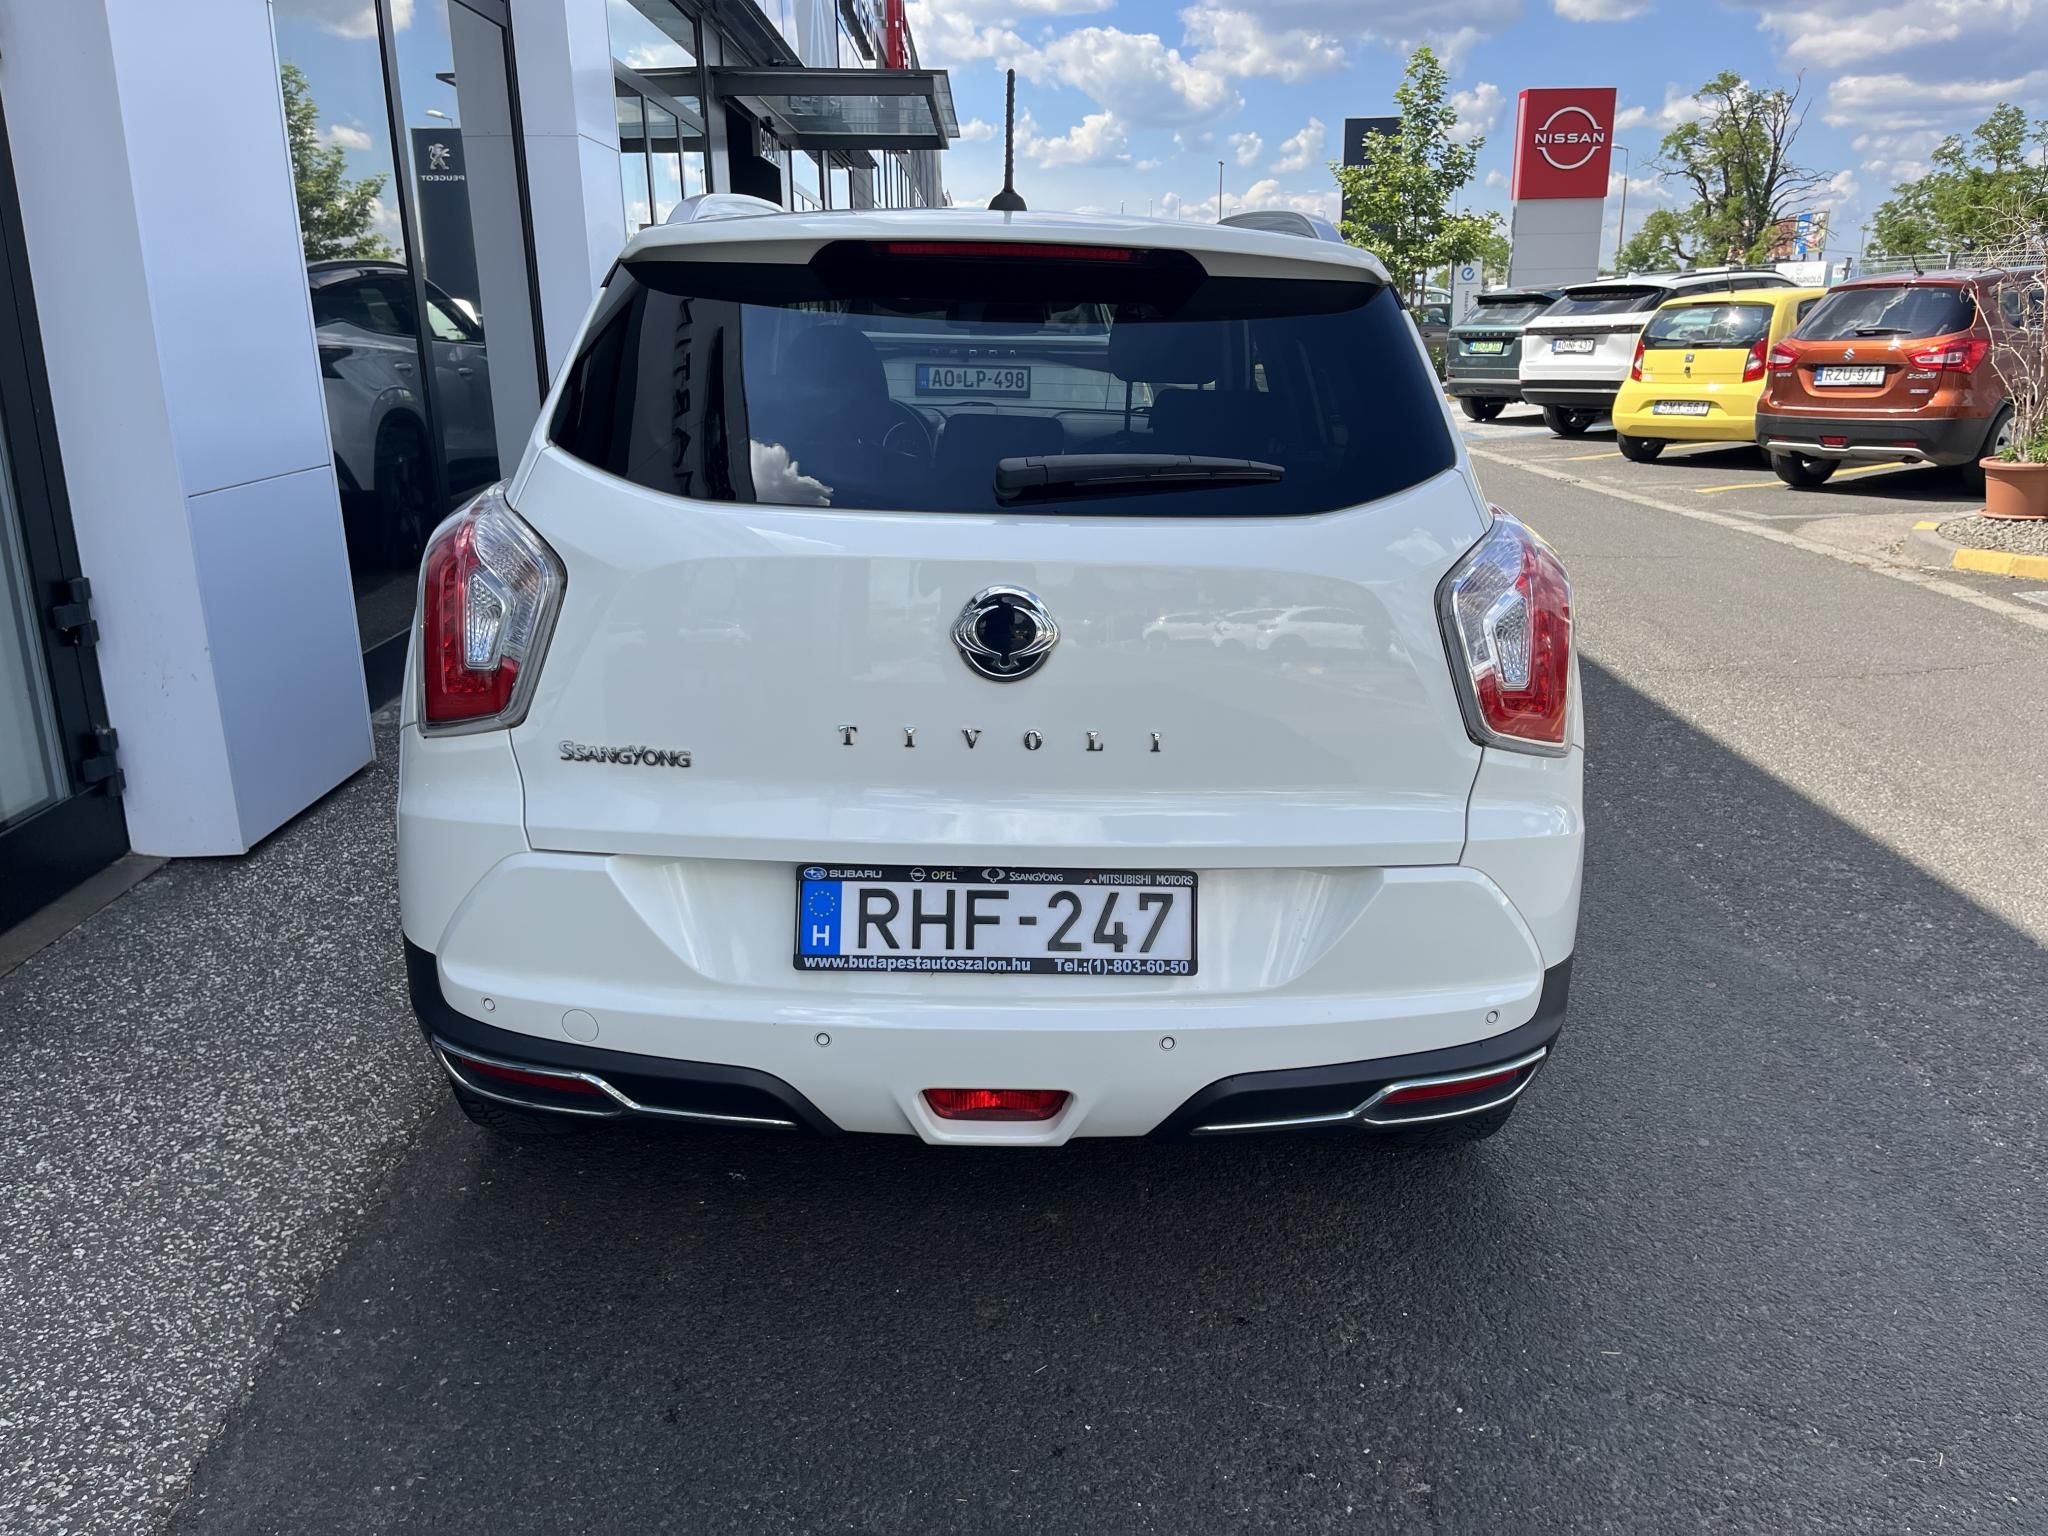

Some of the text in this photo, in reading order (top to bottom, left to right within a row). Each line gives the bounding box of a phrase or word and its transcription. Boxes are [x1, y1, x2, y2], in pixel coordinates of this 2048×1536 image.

[1534, 132, 1605, 144] NISSAN
[1824, 368, 1881, 382] RZU-971
[838, 724, 1161, 753] TIVOLI
[829, 869, 882, 879] SUBARU
[931, 870, 958, 881] OPEL
[1098, 873, 1151, 885] MITSUBISHI
[1156, 874, 1194, 886] MOTORS
[812, 888, 1175, 953] H RHF-247
[803, 955, 1031, 972] www.budapestautoszalon.hu
